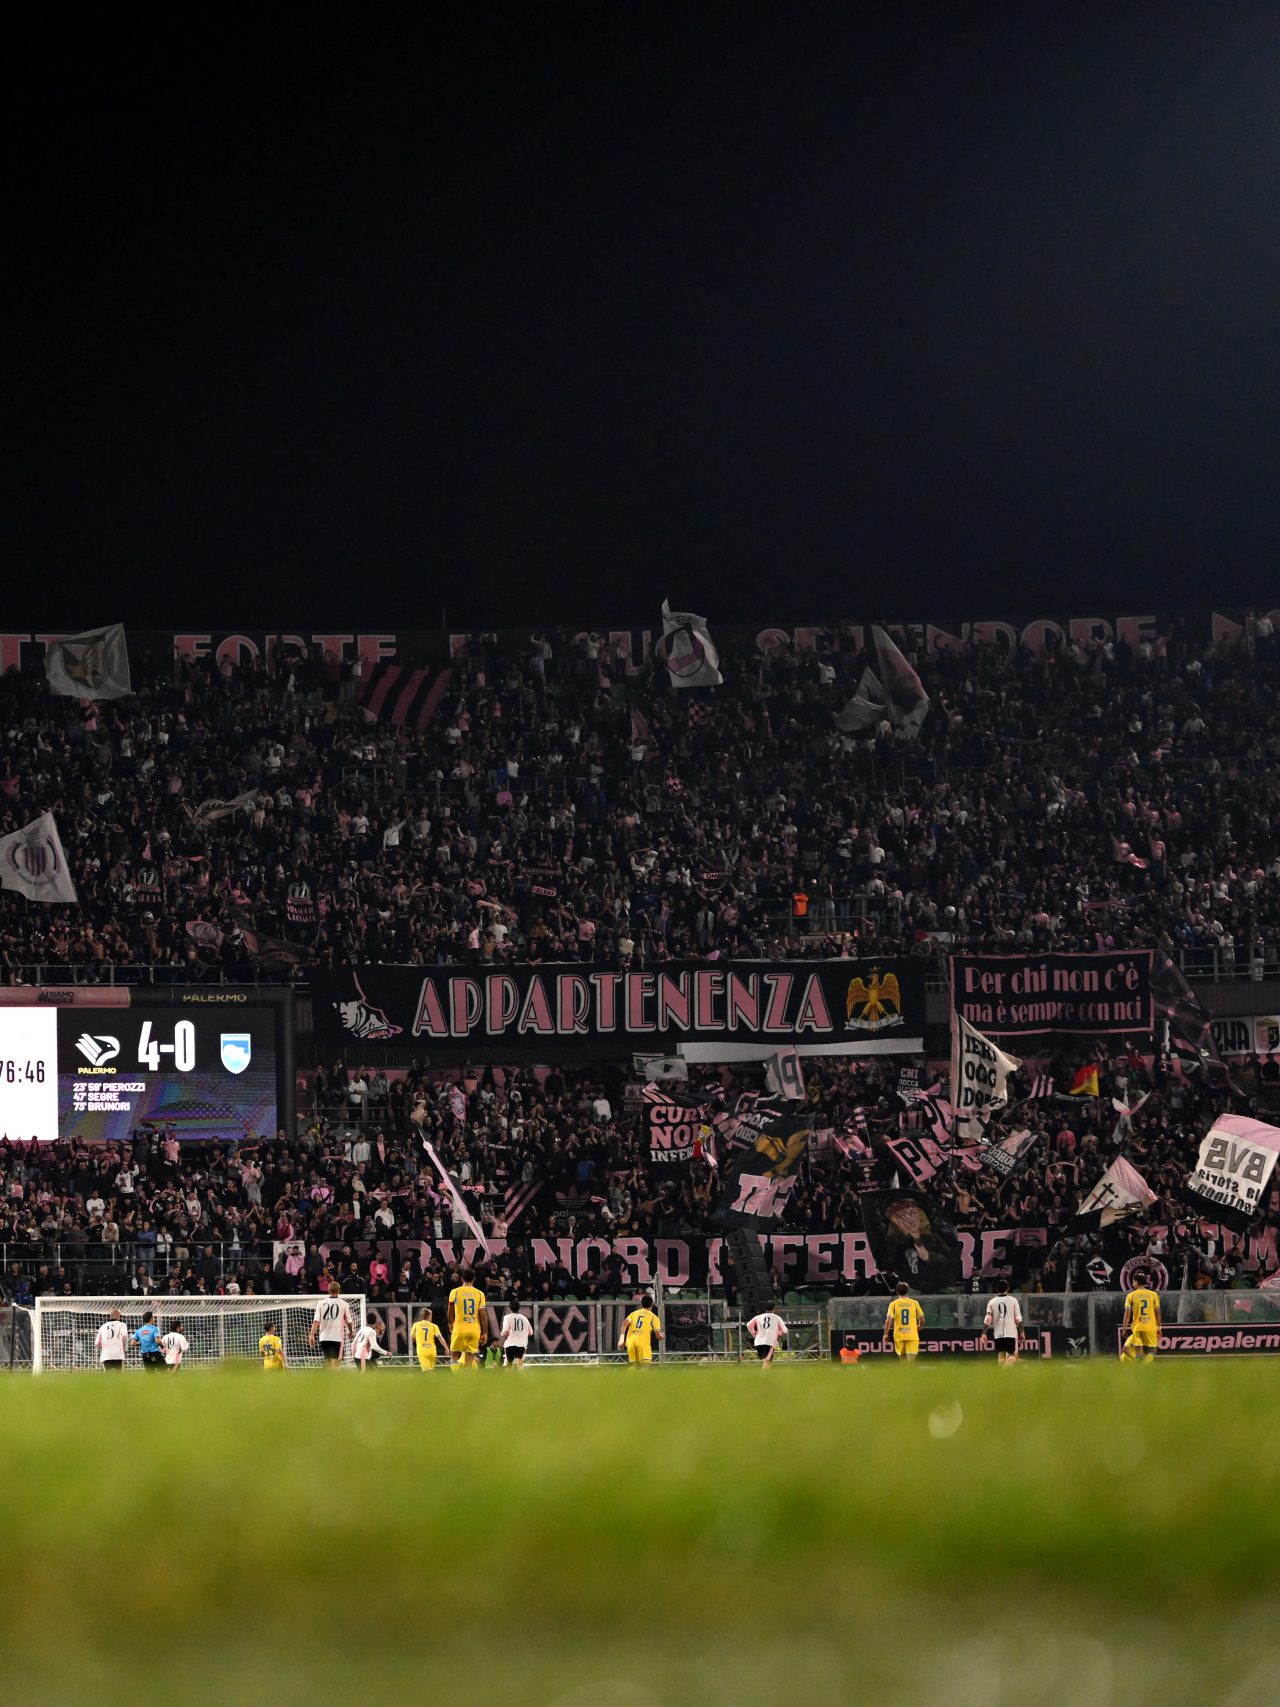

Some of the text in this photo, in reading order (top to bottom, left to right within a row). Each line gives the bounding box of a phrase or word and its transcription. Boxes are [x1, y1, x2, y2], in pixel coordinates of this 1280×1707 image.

[964, 961, 1140, 994] Per chi non c'è
[182, 993, 247, 1003] PALERMO
[412, 970, 834, 1037] APPARTENENZA
[963, 996, 1142, 1024] ma è sempre con noi
[138, 1020, 195, 1072] 4-0
[77, 1067, 117, 1075] PALERMO
[103, 1083, 145, 1092] PIEROZZI
[88, 1093, 119, 1102] SEGRE
[88, 1102, 130, 1111] BRUNORI
[530, 1236, 689, 1286] NORD
[323, 1302, 339, 1320] 20
[463, 1300, 475, 1317] 13
[1140, 1300, 1147, 1315] 2
[513, 1317, 524, 1331] 10
[636, 1316, 644, 1329] 6
[763, 1316, 771, 1330] 8
[900, 1309, 909, 1326] 8
[422, 1328, 429, 1342] 7
[1157, 1331, 1280, 1352] orzapalerm
